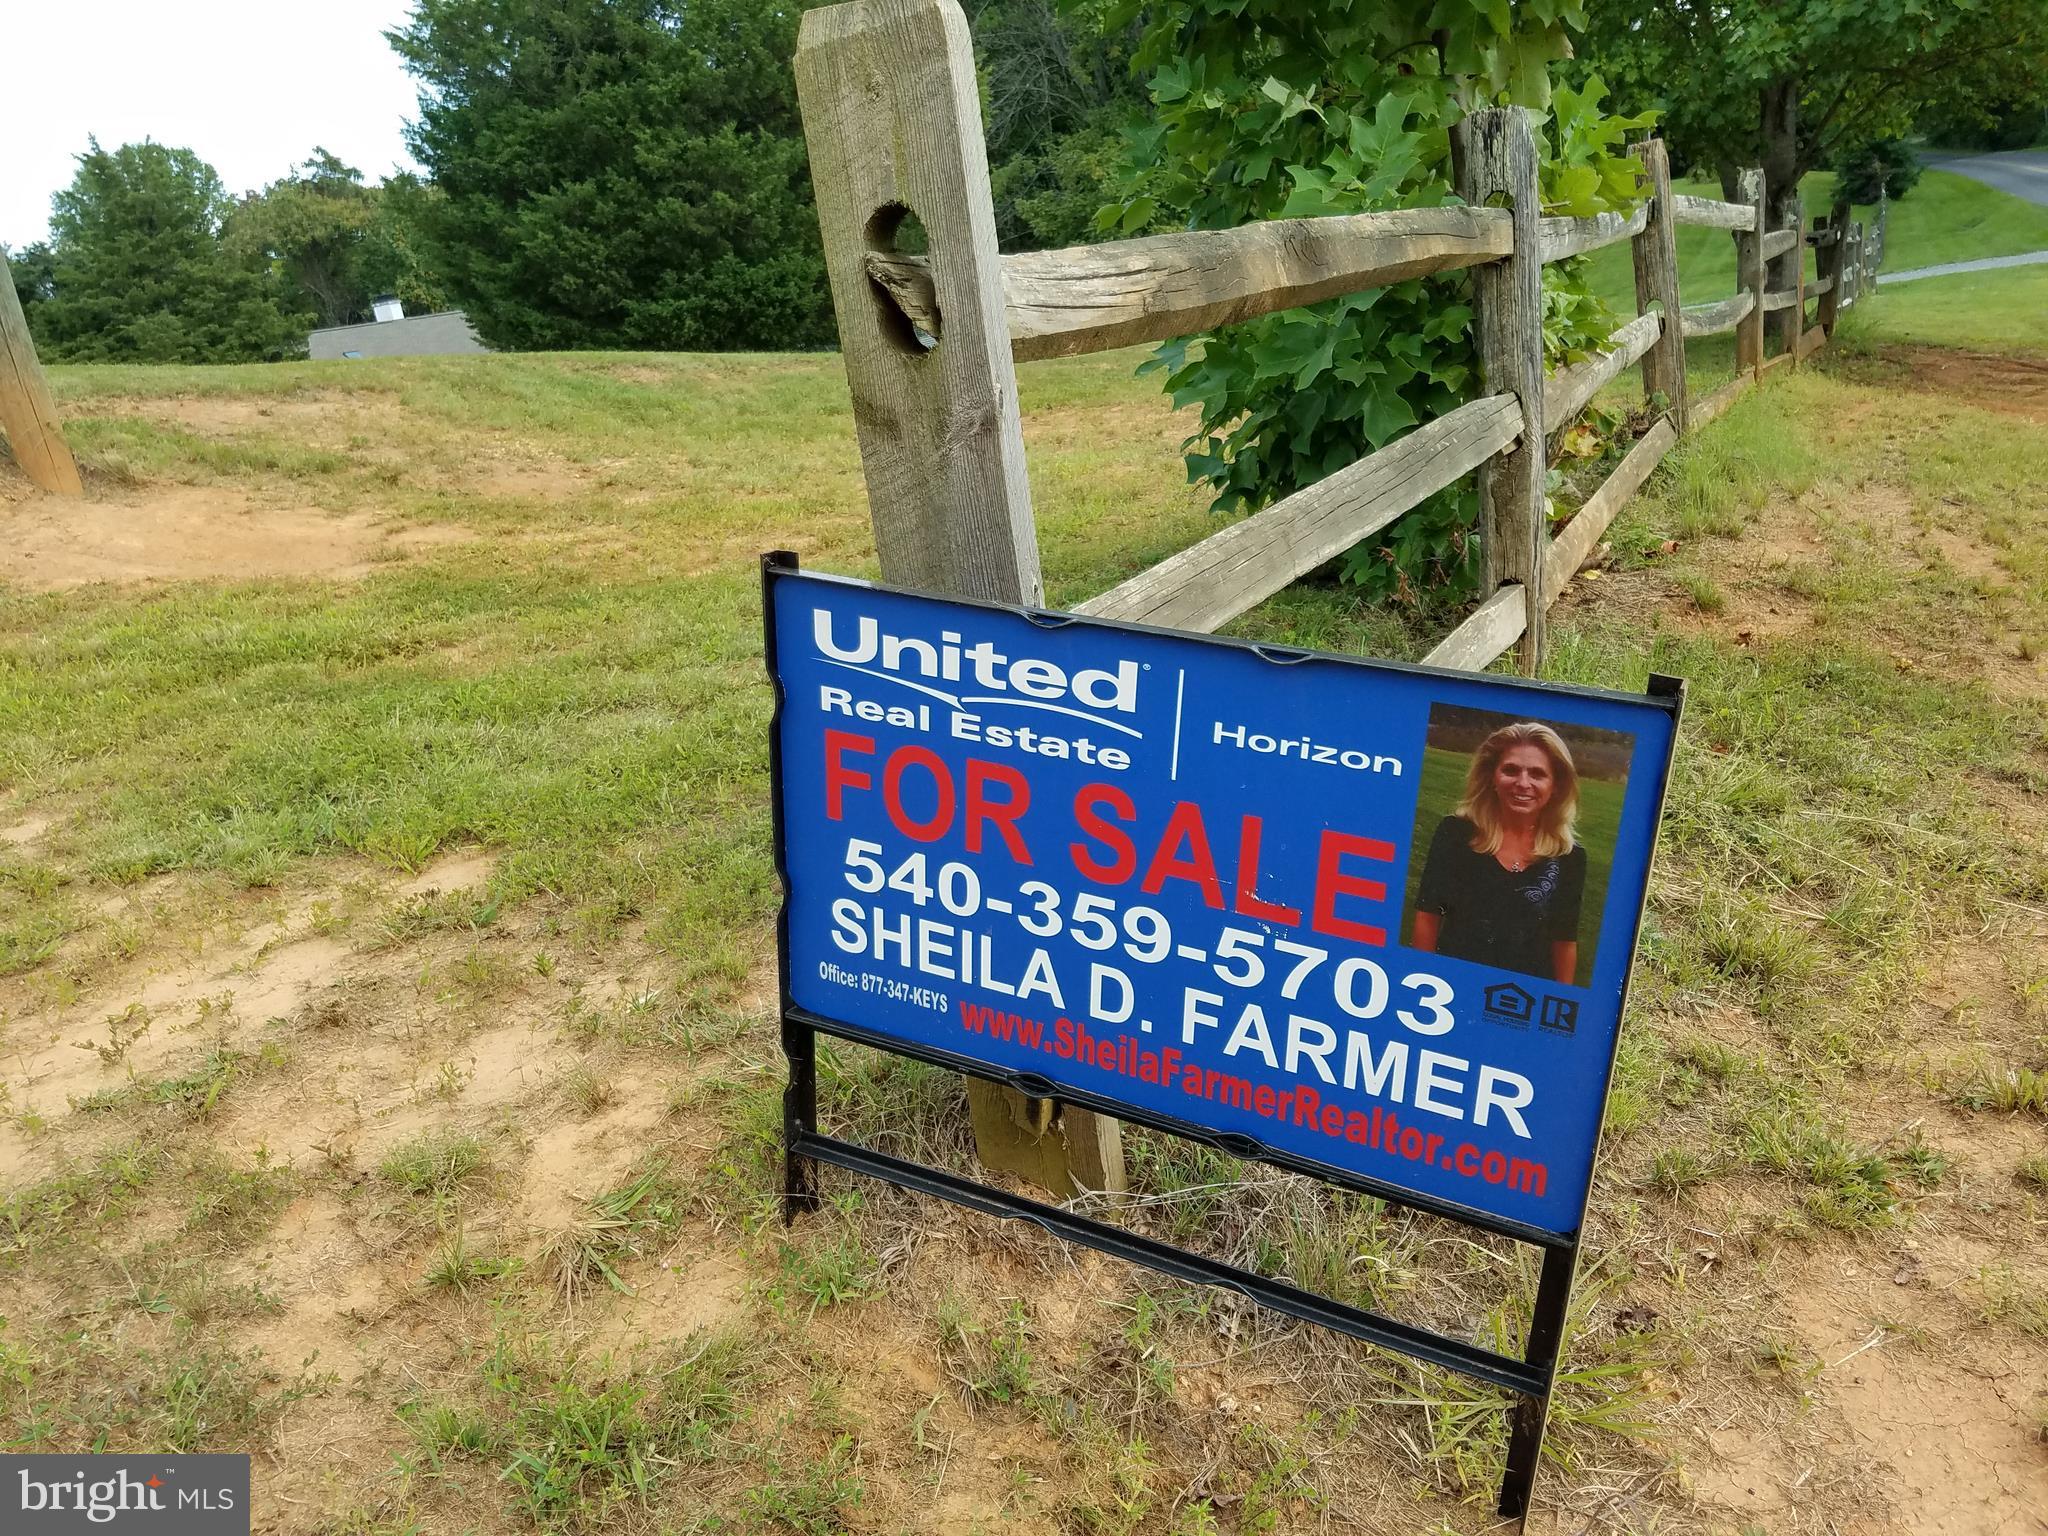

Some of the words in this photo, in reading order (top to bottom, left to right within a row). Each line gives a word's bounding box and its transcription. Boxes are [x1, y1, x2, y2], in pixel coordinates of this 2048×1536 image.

[814, 609, 1139, 713] United
[821, 686, 930, 732] Real
[951, 711, 1131, 770] Estate
[1213, 722, 1402, 776] Horizon
[825, 729, 1033, 865] FOR
[1070, 783, 1395, 947] SALE
[819, 961, 858, 988] Office:
[861, 972, 948, 1013] 877-347-KEYS
[844, 837, 1455, 1036] 540-359-5703
[831, 898, 1066, 1010] SHEILA
[1089, 962, 1153, 1034] D.
[1182, 986, 1534, 1139] FARMER
[960, 1001, 1547, 1197] www.SheilaFarmerRealtor.com
